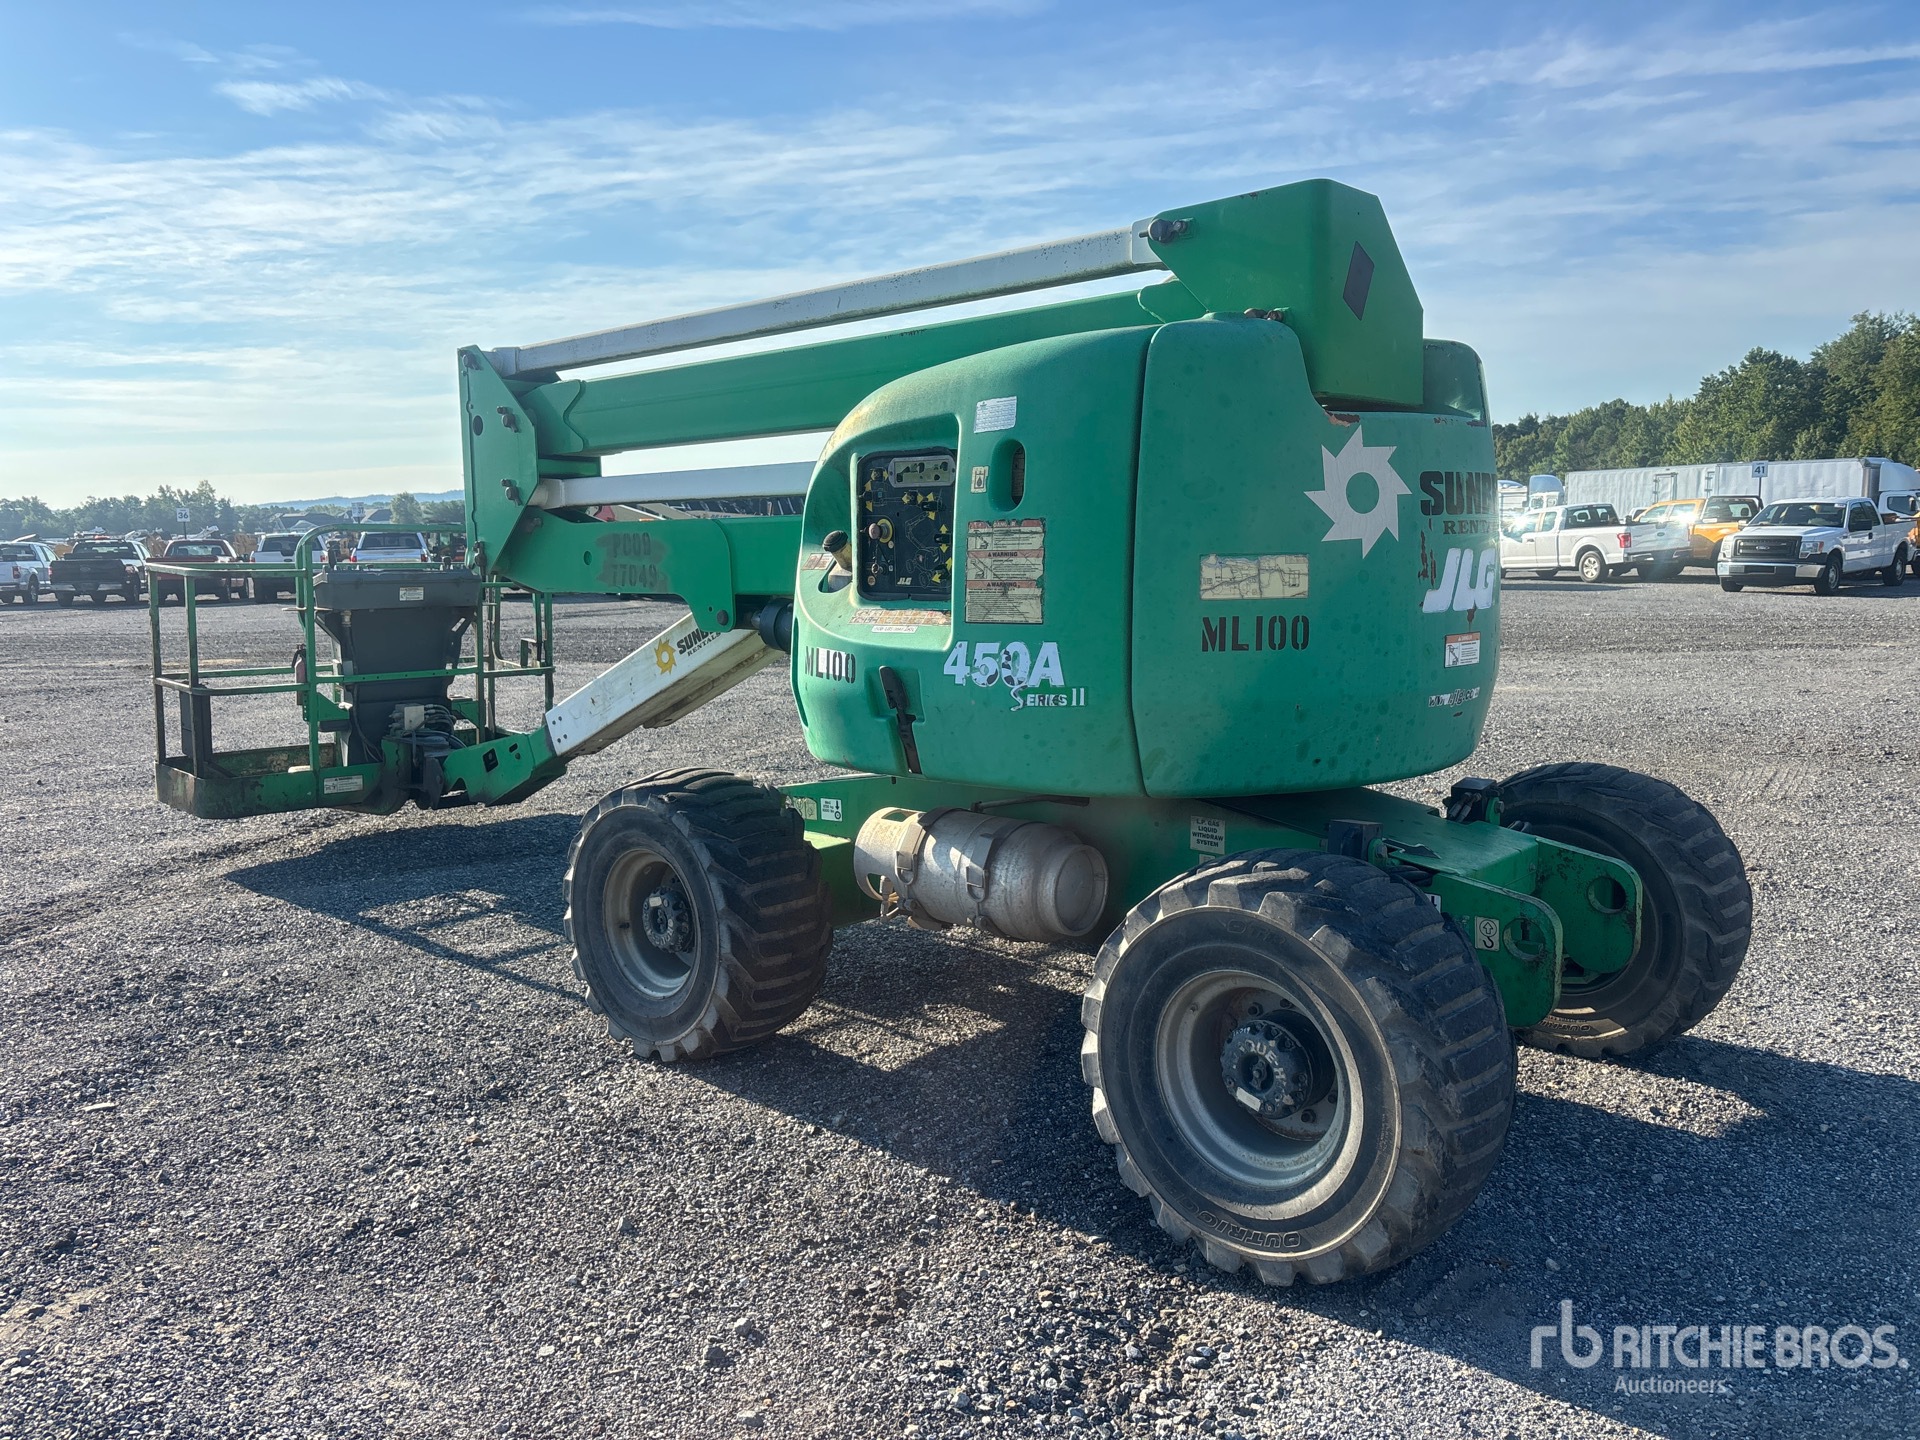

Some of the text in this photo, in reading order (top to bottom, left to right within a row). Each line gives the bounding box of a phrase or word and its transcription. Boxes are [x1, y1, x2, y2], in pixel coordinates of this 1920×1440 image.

[1754, 465, 1765, 474] 41
[1420, 470, 1498, 516] SUNB
[177, 511, 189, 519] 36
[897, 577, 913, 585] JLG
[1422, 547, 1496, 613] JLG
[1201, 615, 1310, 652] ML100
[804, 645, 856, 684] ML100
[943, 640, 1065, 688] 450A
[1192, 831, 1224, 842] WITHDRAW
[1196, 839, 1219, 847] SYSTEM
